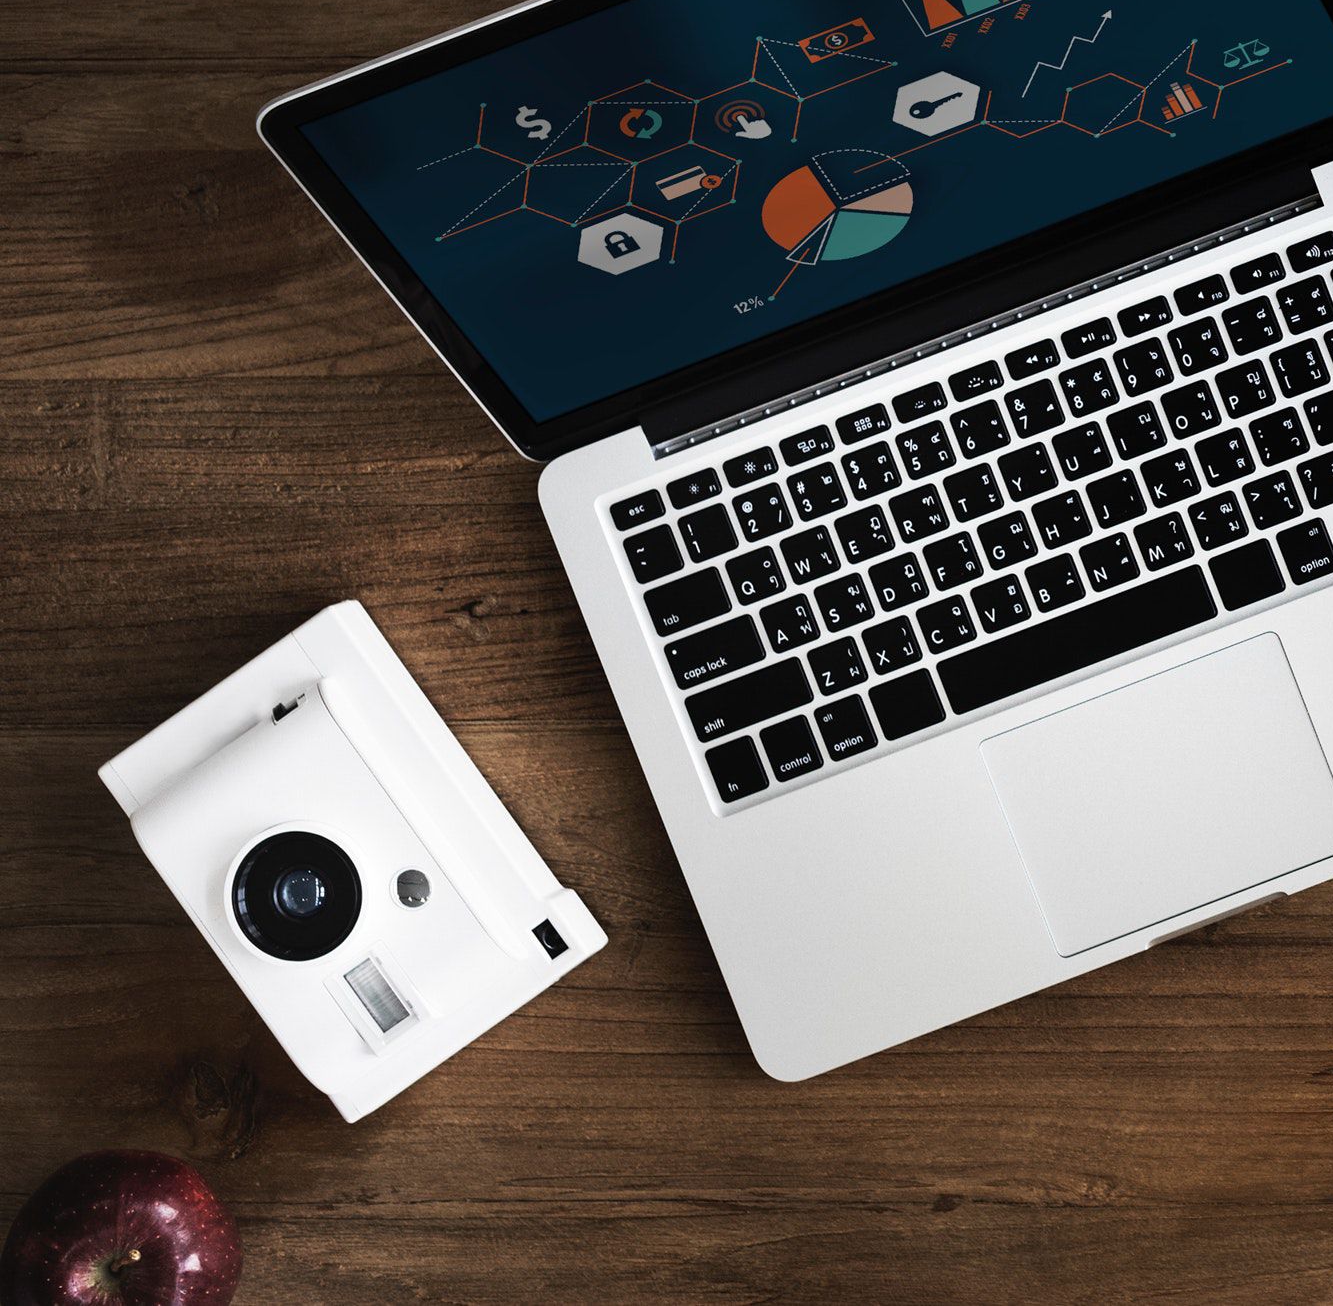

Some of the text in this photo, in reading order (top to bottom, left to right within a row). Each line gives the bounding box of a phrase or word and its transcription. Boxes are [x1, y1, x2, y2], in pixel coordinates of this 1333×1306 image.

[1323, 248, 1333, 257] F12
[734, 296, 763, 313] 12%
[1228, 395, 1239, 410] P
[1175, 415, 1188, 429] O
[1065, 456, 1079, 471] U
[1207, 465, 1219, 478] L
[709, 484, 716, 492] F1
[1011, 477, 1022, 491] Y
[1153, 483, 1167, 499] K
[628, 504, 645, 516] esc
[957, 498, 968, 512] T
[1103, 505, 1110, 519] J
[902, 520, 915, 534] R
[1045, 524, 1060, 540] H
[1308, 527, 1318, 536] alt
[848, 540, 859, 555] E
[992, 545, 1006, 560] G
[1148, 545, 1165, 562] M
[794, 558, 810, 575] W
[1300, 556, 1330, 573] option
[936, 566, 946, 581] F
[1093, 566, 1108, 582] N
[741, 580, 756, 595] Q
[882, 587, 896, 602] D
[1038, 588, 1051, 603] B
[663, 614, 679, 625] tab
[828, 608, 840, 623] S
[984, 608, 995, 622] V
[777, 629, 789, 644] A
[931, 629, 943, 644] C
[876, 649, 890, 665] X
[684, 657, 727, 680] caps lock
[821, 671, 835, 687] Z
[823, 713, 833, 722] alt
[704, 718, 725, 733] shift
[833, 735, 864, 751] option
[780, 753, 812, 772] control
[728, 783, 739, 792] fn
